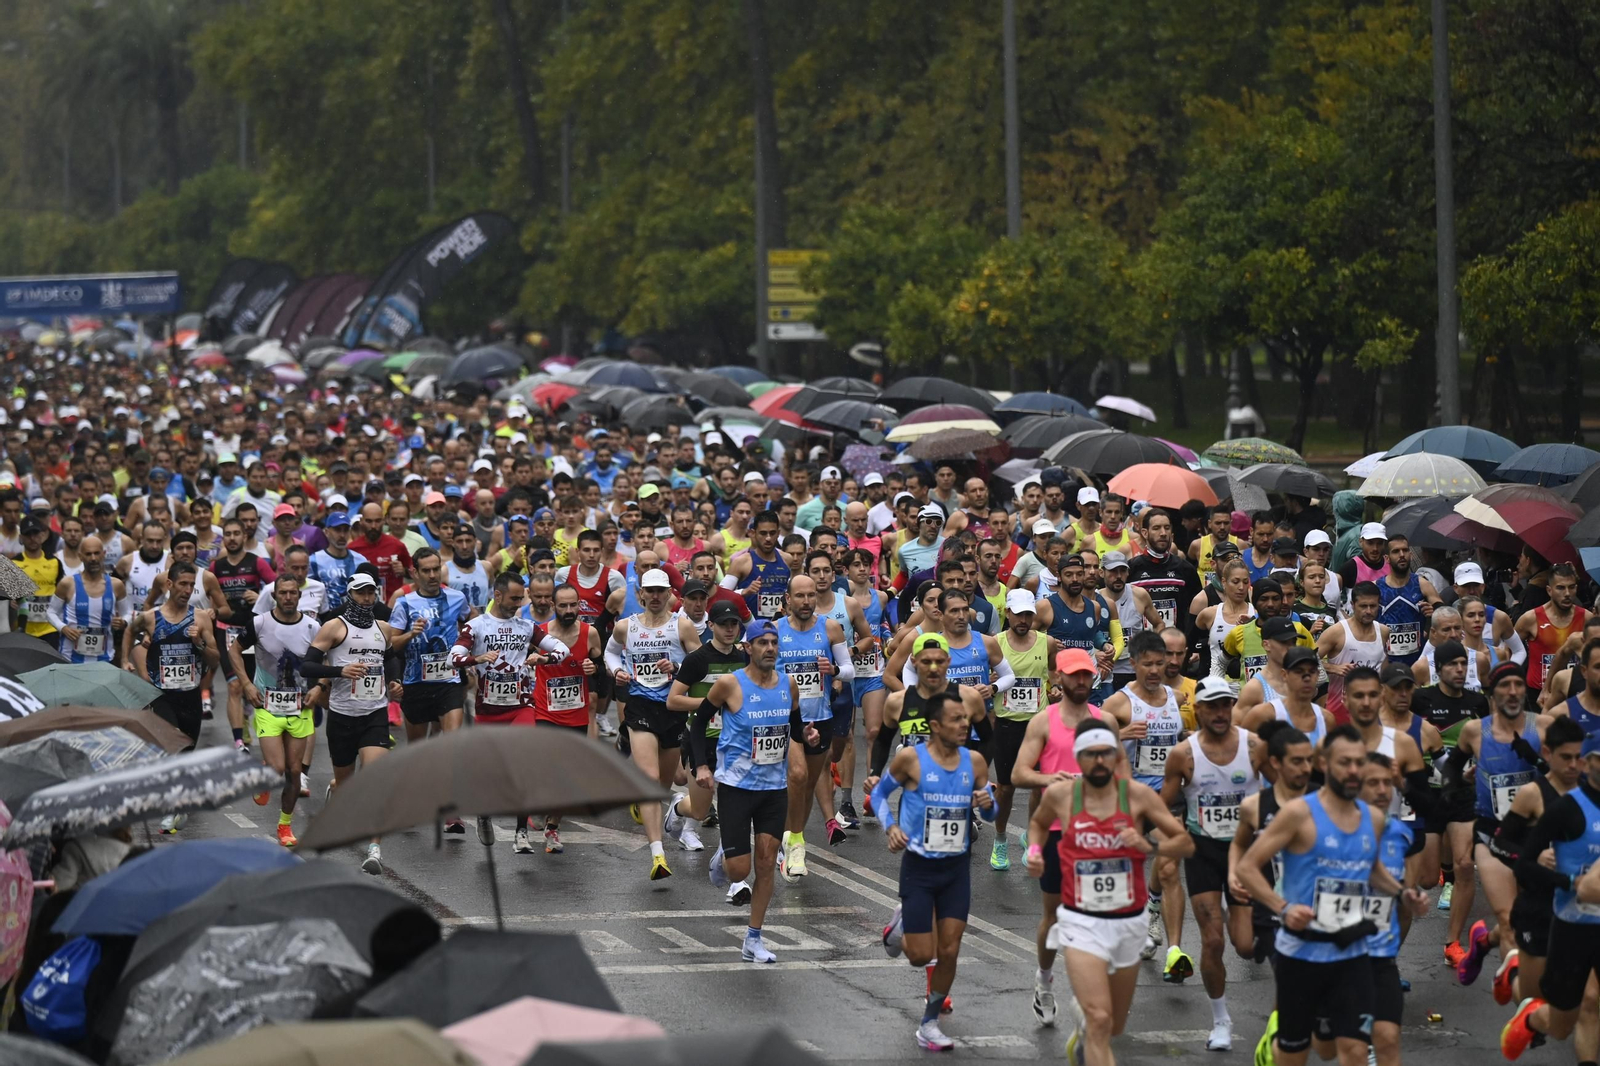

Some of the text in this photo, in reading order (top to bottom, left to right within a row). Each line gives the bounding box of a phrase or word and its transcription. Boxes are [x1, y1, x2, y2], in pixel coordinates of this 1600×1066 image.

[426, 217, 478, 268] POWER
[223, 578, 247, 588] LUCAS
[497, 627, 512, 635] CLUB
[85, 636, 98, 646] 89
[484, 634, 528, 644] ATLETISMO
[632, 640, 672, 649] MARACENA
[1390, 633, 1418, 646] 2039
[486, 643, 526, 652] MONTORO
[780, 650, 826, 659] TROTASIERRA
[164, 666, 192, 678] 2164
[426, 662, 454, 674] 214
[636, 663, 664, 677] 202
[946, 665, 985, 676] OTASIERRA
[363, 677, 377, 688] 67
[791, 673, 820, 686] 924
[489, 682, 517, 695] 1126
[552, 686, 579, 699] 1279
[1011, 688, 1032, 700] 851
[269, 692, 297, 703] 1944
[1146, 721, 1179, 731] ARACENA
[757, 736, 785, 752] 1900
[1150, 748, 1167, 762] 55
[1204, 807, 1241, 823] 1548
[941, 822, 960, 837] 19
[1093, 876, 1115, 894] 69
[1333, 898, 1351, 915] 14
